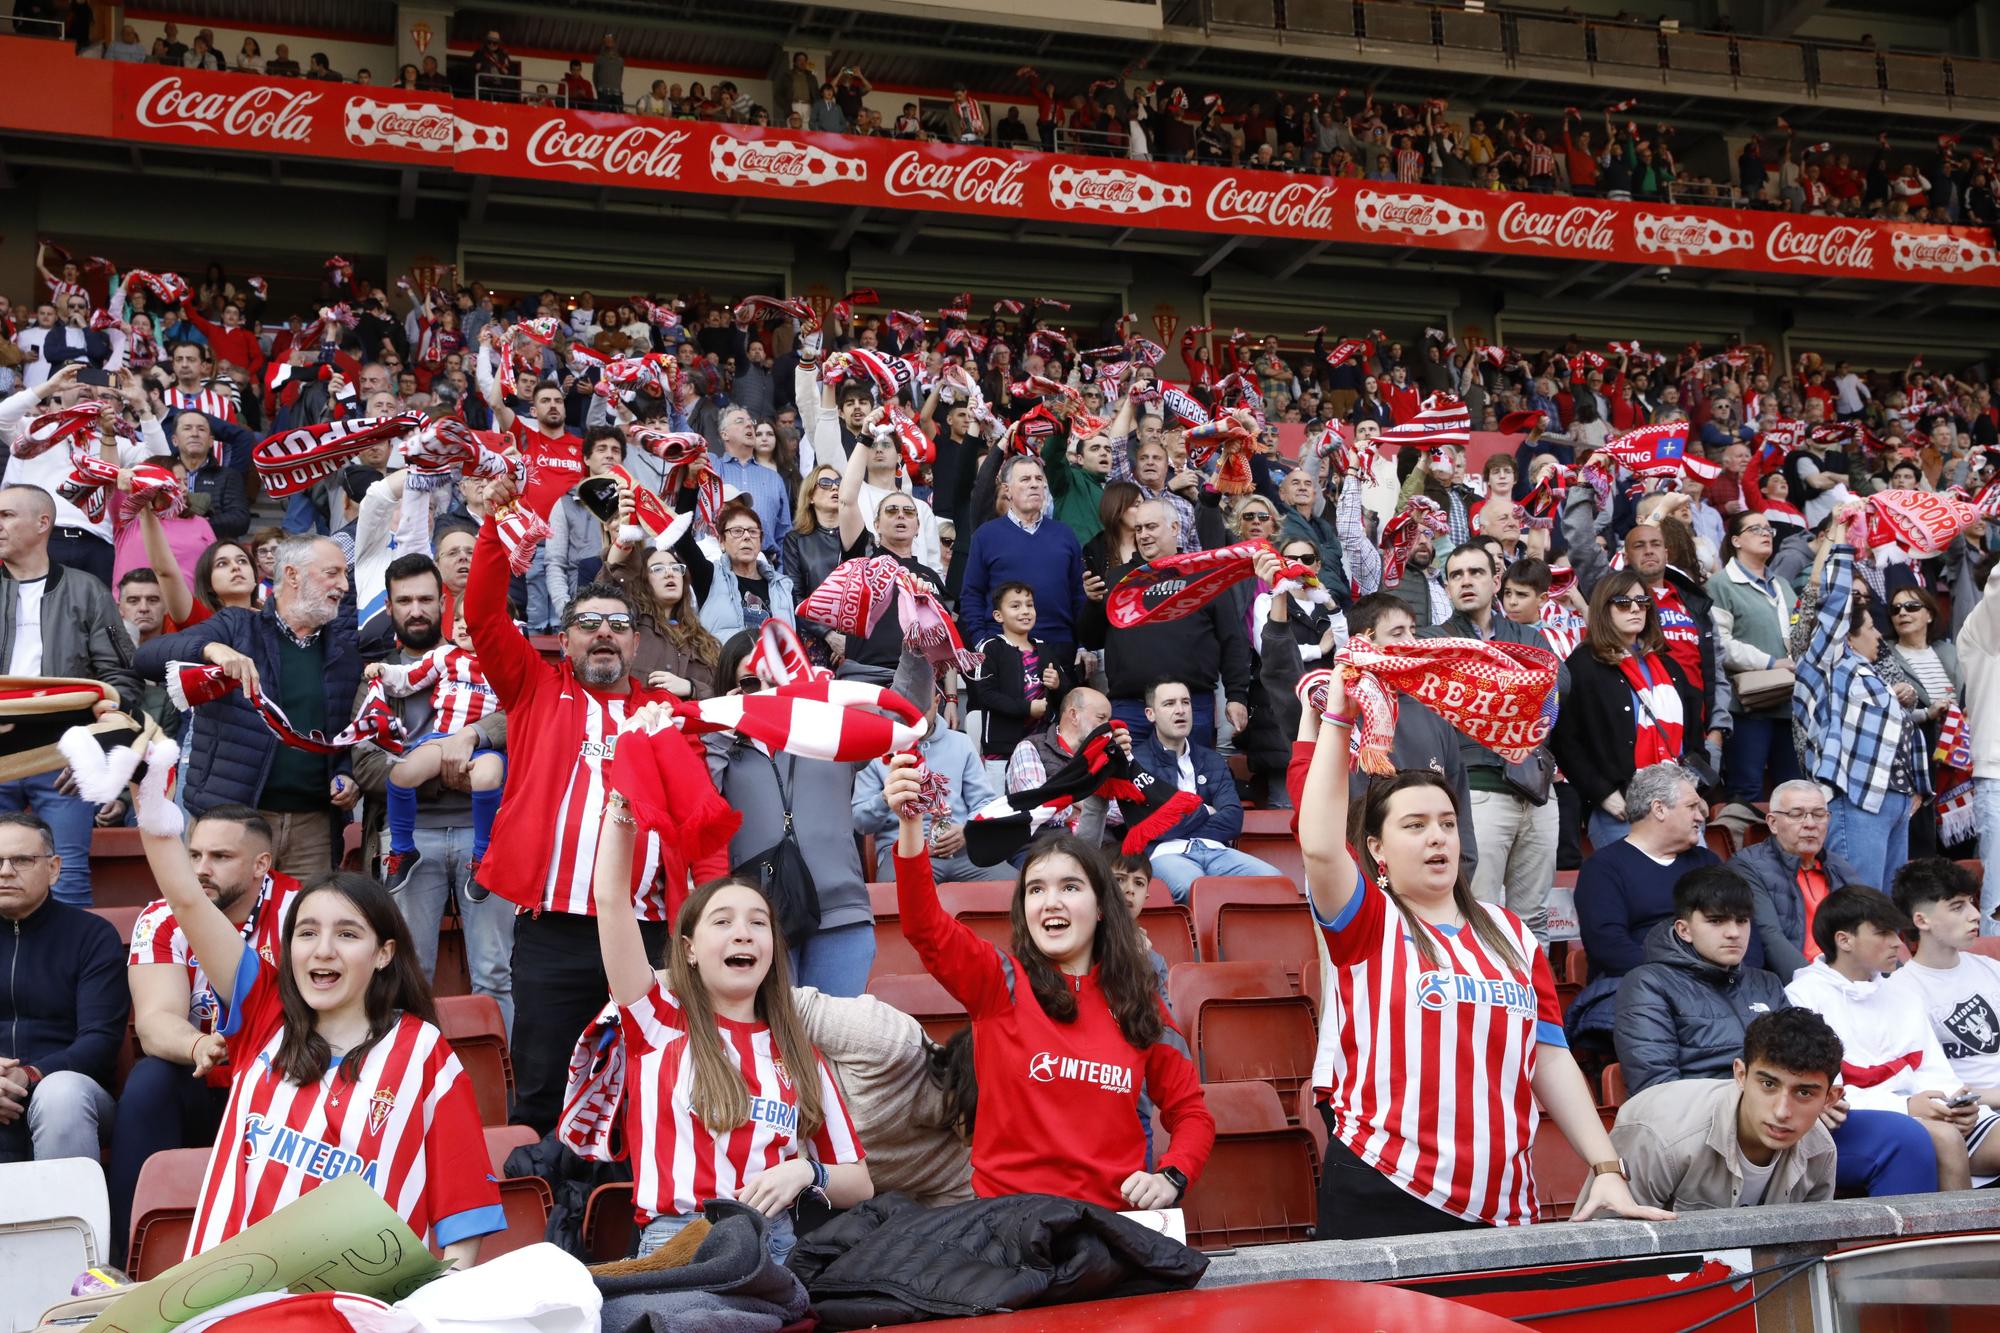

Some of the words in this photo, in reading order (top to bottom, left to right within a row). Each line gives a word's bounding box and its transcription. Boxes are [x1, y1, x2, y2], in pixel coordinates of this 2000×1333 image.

[136, 76, 323, 143] Coca-Cola
[526, 118, 691, 179] Coca-Cola
[884, 150, 1024, 203] Coca-Cola
[1205, 178, 1338, 228] Coca-Cola
[1497, 202, 1618, 248] Coca-Cola
[1766, 222, 1876, 268] Coca-Cola
[1617, 451, 1651, 464] TING
[1663, 629, 1699, 645] urias
[1416, 672, 1520, 718] REAL
[1426, 704, 1551, 744] RTING
[1454, 976, 1537, 1012] INTEGRA
[1949, 998, 1980, 1025] RAIDERS
[1060, 1057, 1132, 1089] INTEGRA
[750, 1098, 796, 1130] EGRA
